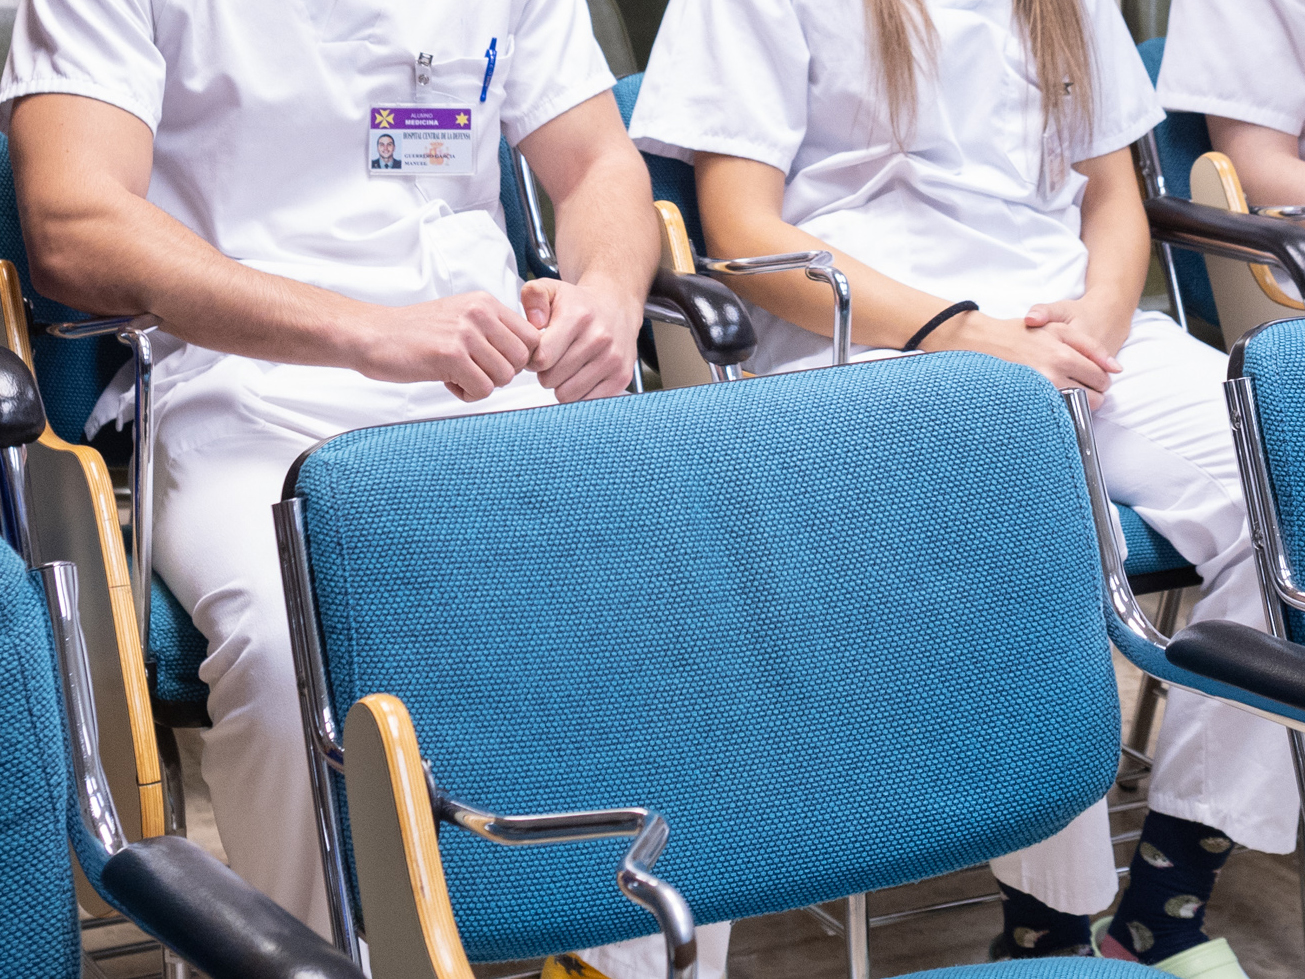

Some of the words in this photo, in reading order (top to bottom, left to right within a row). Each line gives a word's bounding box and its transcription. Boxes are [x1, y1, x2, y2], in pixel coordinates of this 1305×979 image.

[403, 132, 422, 140] HOSPITAL
[422, 132, 440, 140] CENTRAL
[441, 132, 446, 140] DE
[447, 132, 453, 140] LA
[453, 132, 471, 140] DEFENSA
